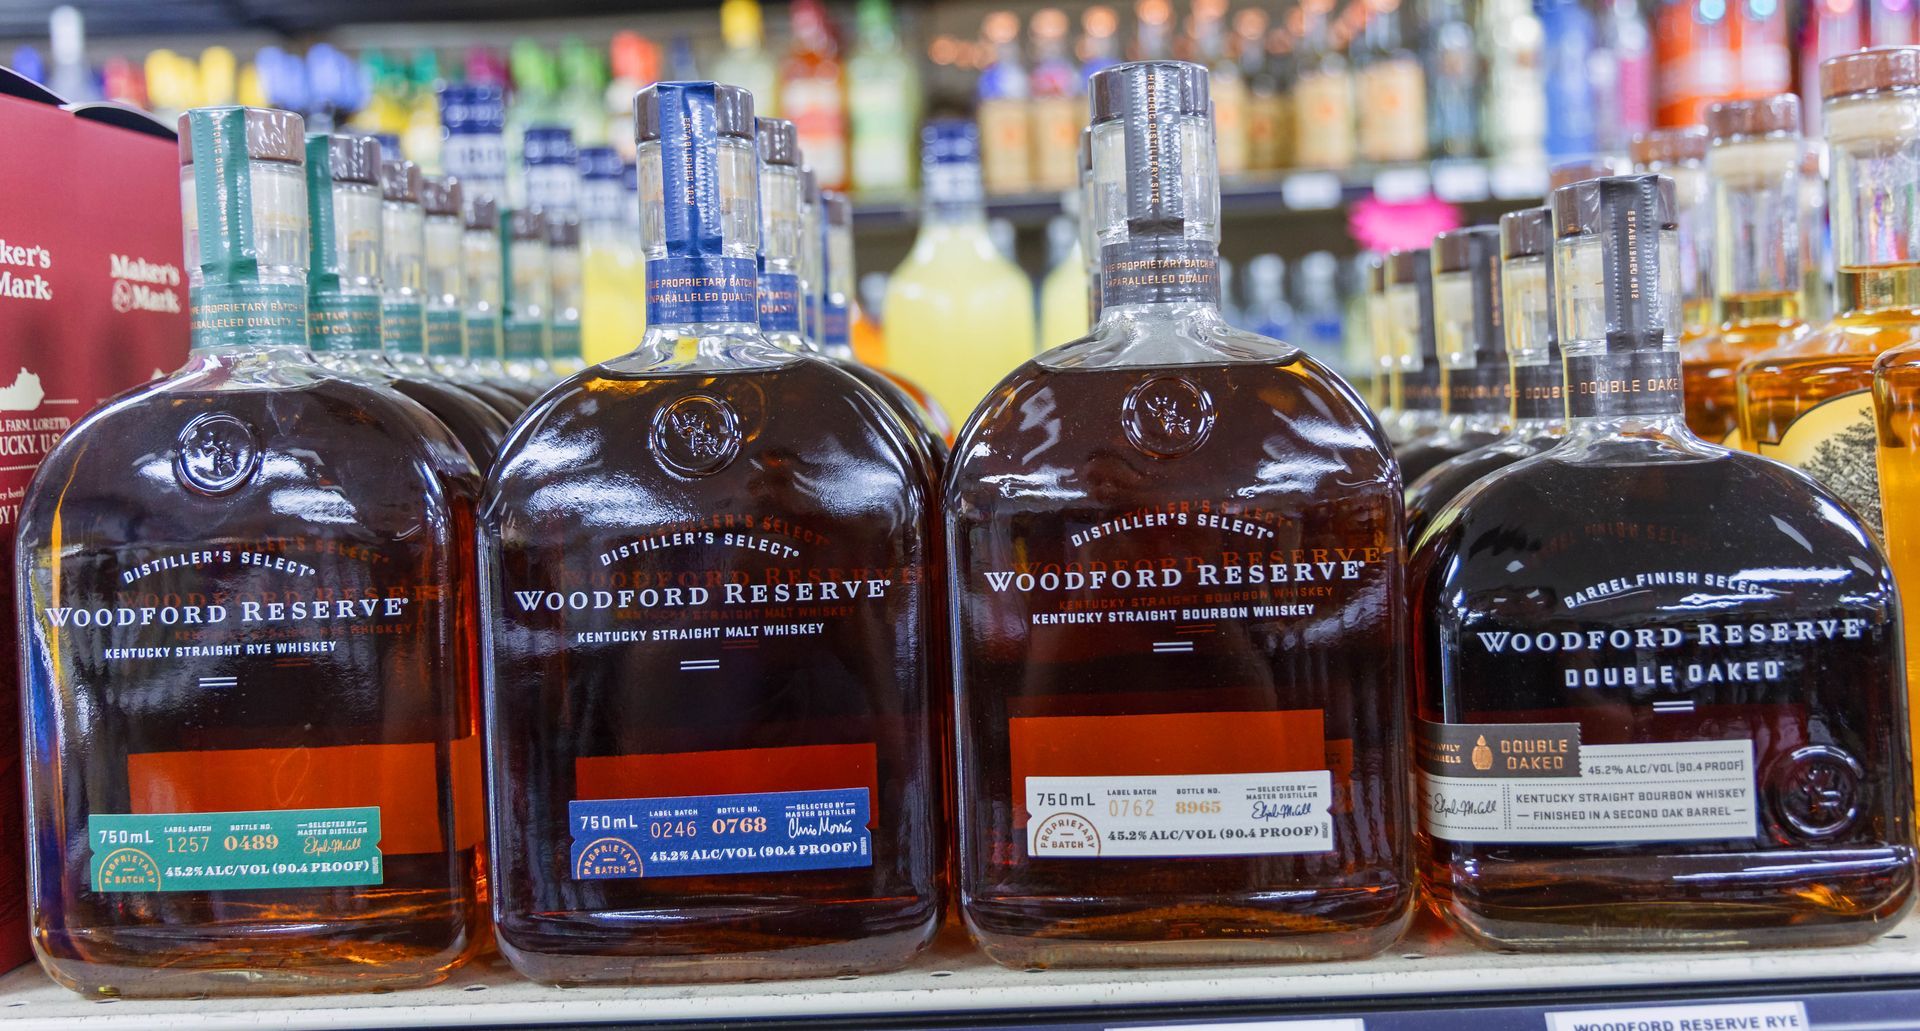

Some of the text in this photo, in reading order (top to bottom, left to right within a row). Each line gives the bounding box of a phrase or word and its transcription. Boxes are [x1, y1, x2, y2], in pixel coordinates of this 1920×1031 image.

[684, 116, 695, 182] ESTABLISHED
[1149, 122, 1159, 180] DISTILLERY
[1151, 182, 1160, 204] SITE
[1627, 210, 1637, 275] ESTABLISHED
[0, 240, 51, 268] ker's
[110, 253, 180, 286] Maker's
[1117, 259, 1181, 271] PROPRIETARY
[661, 278, 727, 288] PROPRIETARY
[132, 284, 180, 313] Mark
[201, 302, 267, 313] PROPRIETARY
[1580, 378, 1682, 394] DOUBLE OAKE
[1071, 512, 1188, 548] DISTILLER'S
[600, 532, 714, 567] DISTILLER'S
[123, 550, 232, 584] DISTILLER'S
[984, 568, 1183, 593] WOODFORD
[513, 586, 709, 611] WOODFORD
[1564, 576, 1632, 609] BARREL
[1635, 571, 1698, 587] FINISH
[45, 604, 228, 628] WOODFORD
[1032, 604, 1315, 625] KENTUCKY STRAIGHT BOURBON WHISKEY
[577, 622, 825, 643] KENTUCKY STRAIGHT MALT WHISKEY
[1476, 627, 1684, 653] WOODFORD
[105, 640, 337, 660] KENTUCKY STRAIGHT RYE WHISKEY
[1564, 665, 1674, 688] DOUBLE
[1500, 738, 1568, 754] DOUBLE
[1506, 756, 1564, 770] OAKED
[1587, 764, 1623, 775] 45.2%
[1626, 763, 1673, 775] ALC/VOL
[1133, 788, 1157, 796] BATCH
[1246, 791, 1318, 801] MASTER DISTILLER
[1297, 784, 1306, 792] BY
[1516, 788, 1746, 804] KENTUCKY STRAIGHT BOURBON WHISKEY
[796, 801, 844, 810] SELECTED BY
[1037, 792, 1096, 807] 750mL
[1108, 799, 1155, 817] 0762
[1175, 800, 1222, 815] 8965
[674, 808, 698, 816] BATCH
[717, 806, 745, 814] BOTTLE
[785, 808, 856, 818] MASTER DISTILLER
[1533, 806, 1731, 821] FINISHED IN A SECOND OAK BARREL
[308, 821, 345, 829] SELECTED
[329, 826, 368, 835] DISTILLER
[580, 814, 638, 830] 750mL
[650, 820, 697, 839] 0246
[711, 816, 767, 835] 0768
[98, 829, 154, 844] 750mL
[1040, 818, 1096, 849] PROPRIETARY
[1107, 830, 1148, 841] 45.2%
[1149, 827, 1216, 841] ALC/VOL
[1219, 827, 1256, 840] (90.4
[1260, 825, 1319, 838] PROOF)
[166, 836, 209, 853] 1257
[223, 834, 279, 851] 0489
[1051, 840, 1084, 849] BATCH
[583, 843, 638, 875] PROPRIETARY
[650, 850, 689, 862] 45.2%
[691, 847, 757, 861] ALC/VOL
[759, 845, 796, 858] (90.4
[799, 841, 858, 855] PROOF)
[105, 854, 156, 884] PROPRIETARY
[165, 866, 204, 877] 45.2%
[205, 863, 270, 876] ALC/VOL
[272, 862, 309, 874] (90.4
[310, 860, 369, 873] PROOF)
[594, 865, 627, 875] BATCH
[114, 875, 145, 884] BATCH
[1679, 1015, 1760, 1031] RESERVE
[1766, 1014, 1800, 1028] RYE
